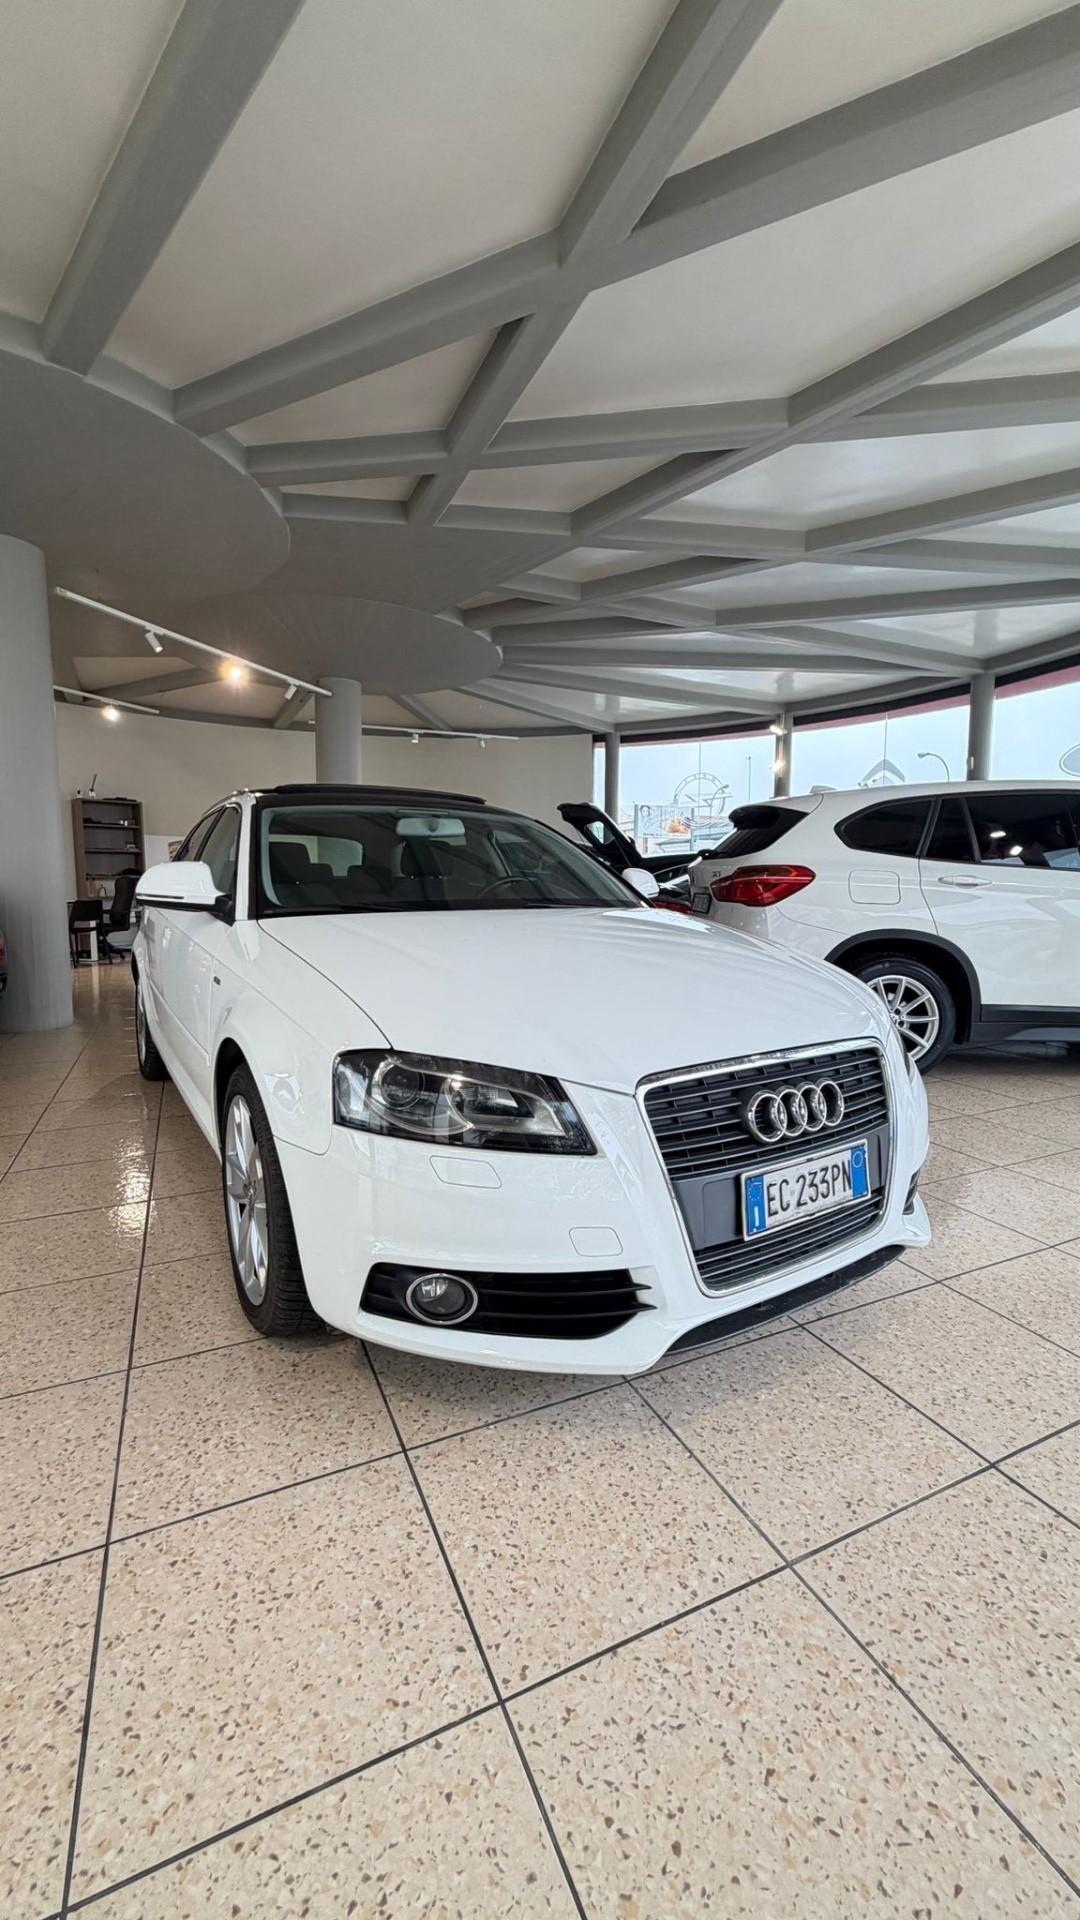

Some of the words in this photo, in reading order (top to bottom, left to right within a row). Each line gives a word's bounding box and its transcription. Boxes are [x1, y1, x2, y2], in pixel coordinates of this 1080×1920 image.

[767, 1179, 790, 1217] EC
[796, 1159, 852, 1208] 233PN
[754, 1205, 759, 1227] I
